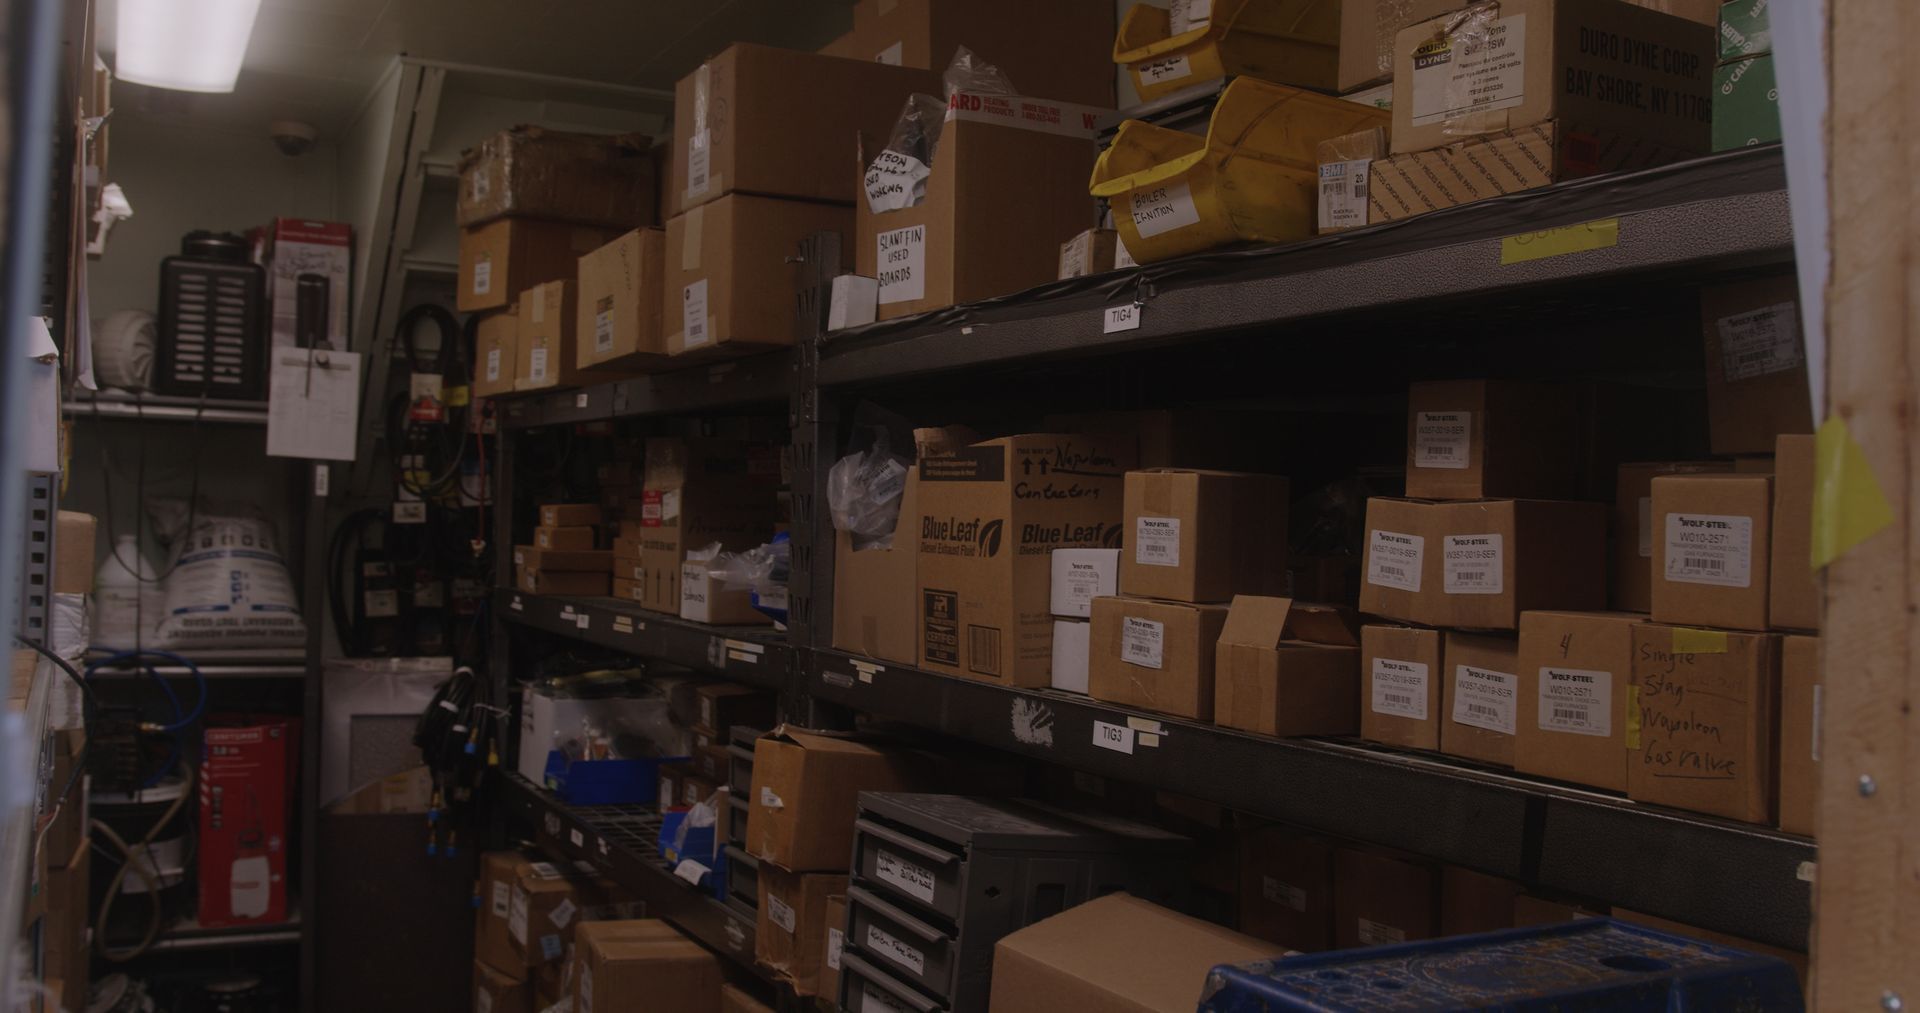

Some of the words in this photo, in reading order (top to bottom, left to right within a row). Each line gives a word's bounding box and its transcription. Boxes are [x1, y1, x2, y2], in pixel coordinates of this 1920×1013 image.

[1417, 42, 1448, 54] DURO
[1580, 27, 1618, 61] DURO
[1623, 37, 1658, 70] DYNE
[1664, 48, 1700, 80] CORP.
[1420, 54, 1451, 66] DYNE
[1566, 68, 1592, 96] BAY
[1597, 74, 1648, 112] SHORE,
[1651, 88, 1670, 116] NY
[950, 94, 981, 111] ARD
[984, 106, 1014, 118] PRODUCTS
[1082, 113, 1097, 130] W
[1355, 174, 1364, 184] 20
[1134, 187, 1167, 209] BOILER
[1134, 204, 1175, 225] IGNITION
[880, 230, 903, 252] SLANT
[905, 227, 922, 247] FIN
[888, 248, 910, 264] USED
[880, 266, 911, 288] BOARDS
[1112, 308, 1132, 323] TIG4
[1014, 482, 1100, 500] Contactors
[922, 516, 948, 540] Blue
[950, 516, 980, 542] Leaf
[1682, 520, 1705, 528] WOLF
[1022, 523, 1060, 544] Blue
[1063, 522, 1104, 543] Leaf
[920, 542, 937, 554] Diesel
[938, 542, 960, 556] Exhaust
[960, 544, 976, 557] Fluid
[1018, 543, 1044, 556] Diesel
[1560, 632, 1572, 659] 4
[1640, 643, 1696, 674] Single
[1486, 675, 1505, 683] STEEL
[1103, 726, 1122, 742] TIG3
[1642, 707, 1721, 744] Napoleon
